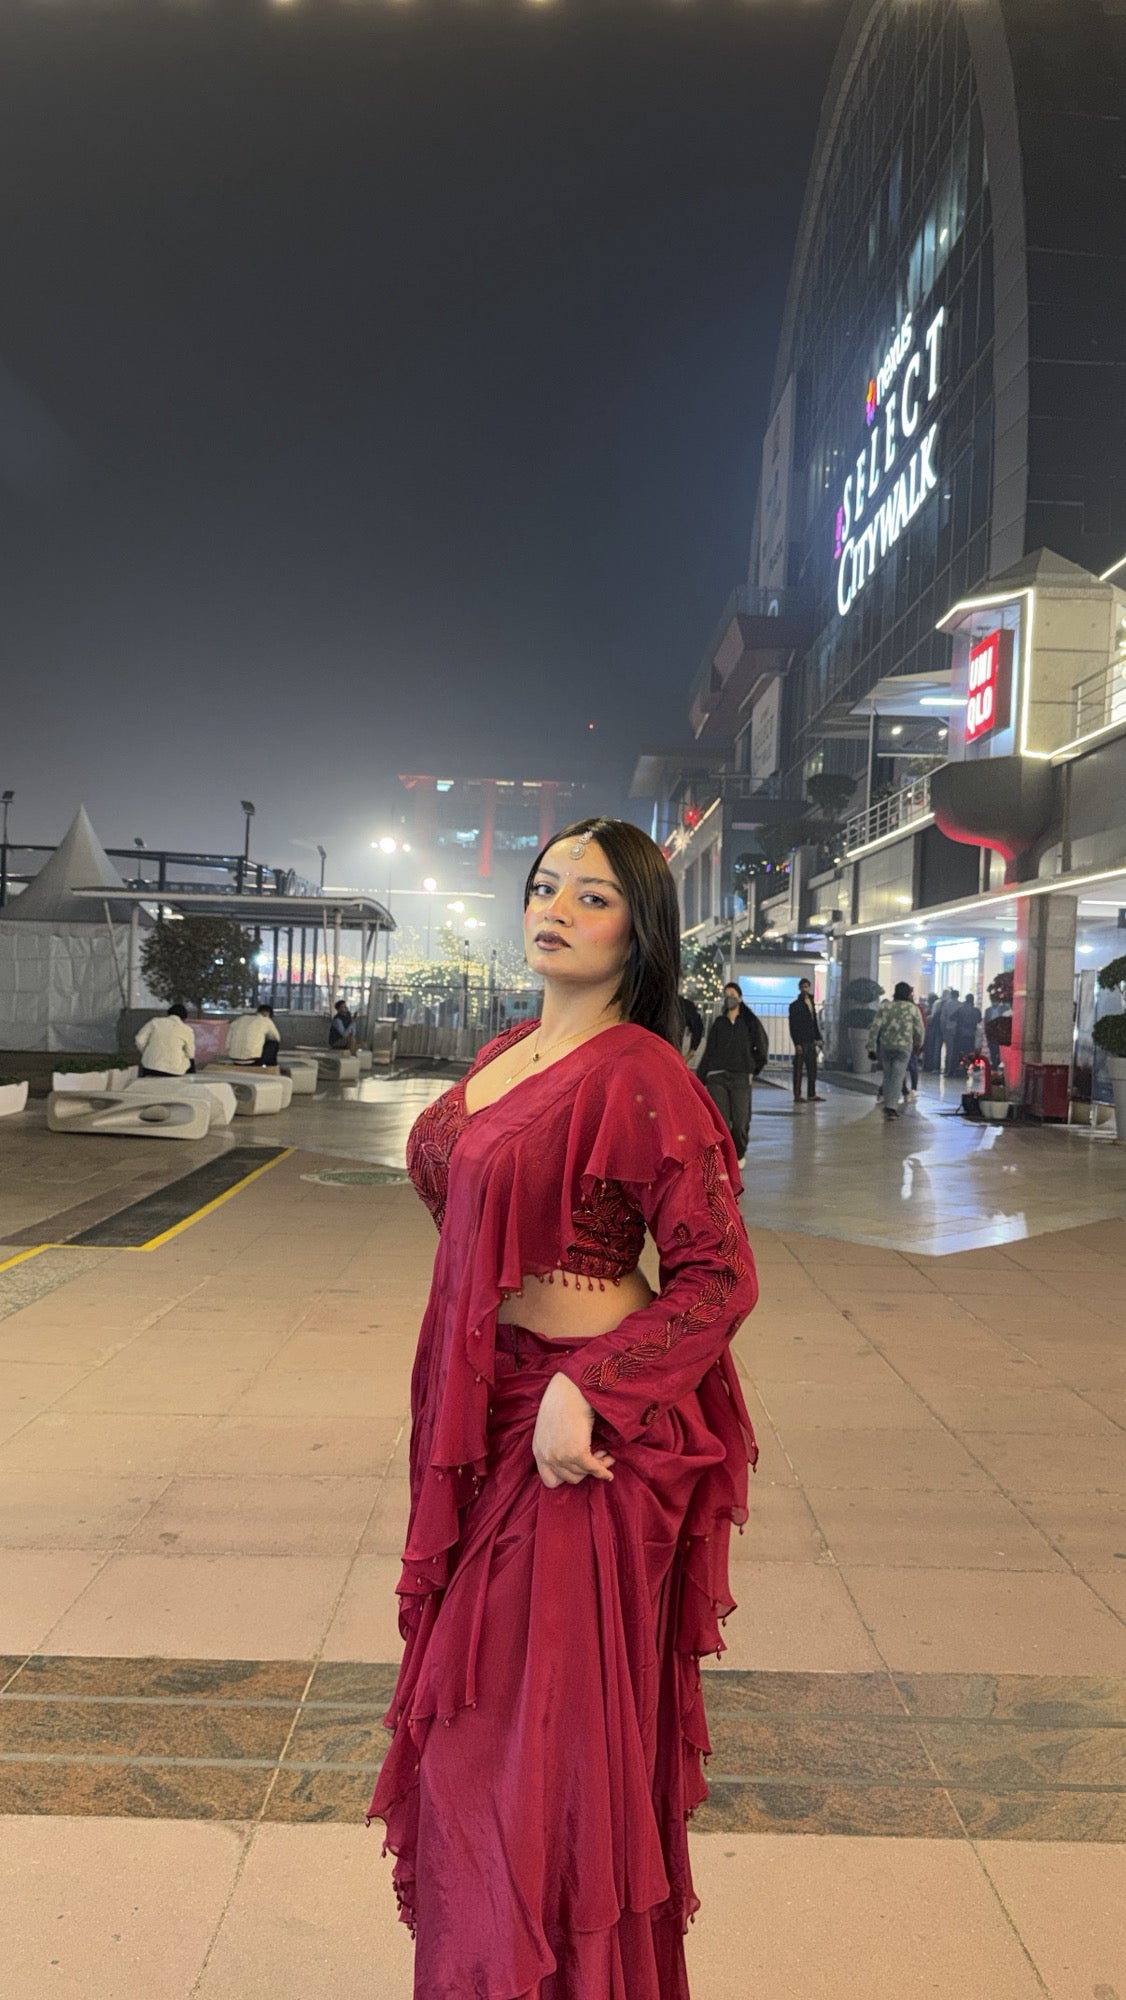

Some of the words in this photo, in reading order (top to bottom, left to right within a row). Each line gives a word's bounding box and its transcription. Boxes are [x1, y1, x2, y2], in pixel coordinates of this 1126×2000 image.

[877, 312, 912, 406] nexus
[842, 306, 944, 543] SELECT
[837, 422, 937, 616] CITYWALK
[967, 686, 993, 734] QLO
[969, 646, 993, 691] UNI
